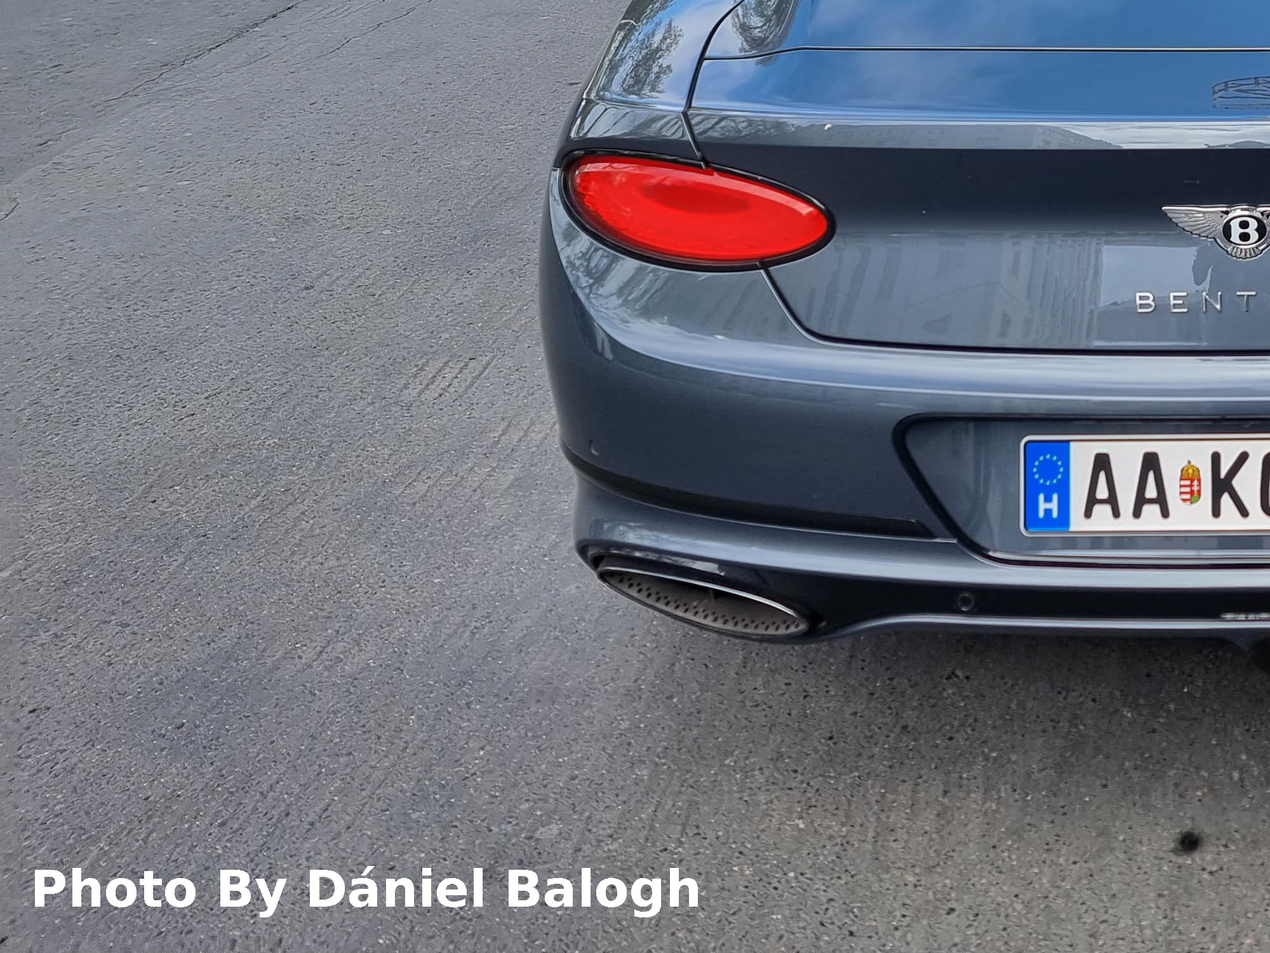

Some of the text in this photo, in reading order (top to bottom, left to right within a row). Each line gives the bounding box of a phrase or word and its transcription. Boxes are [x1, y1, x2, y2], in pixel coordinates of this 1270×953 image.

[1230, 216, 1259, 245] B
[1084, 452, 1170, 519] AA
[1037, 493, 1059, 519] H
